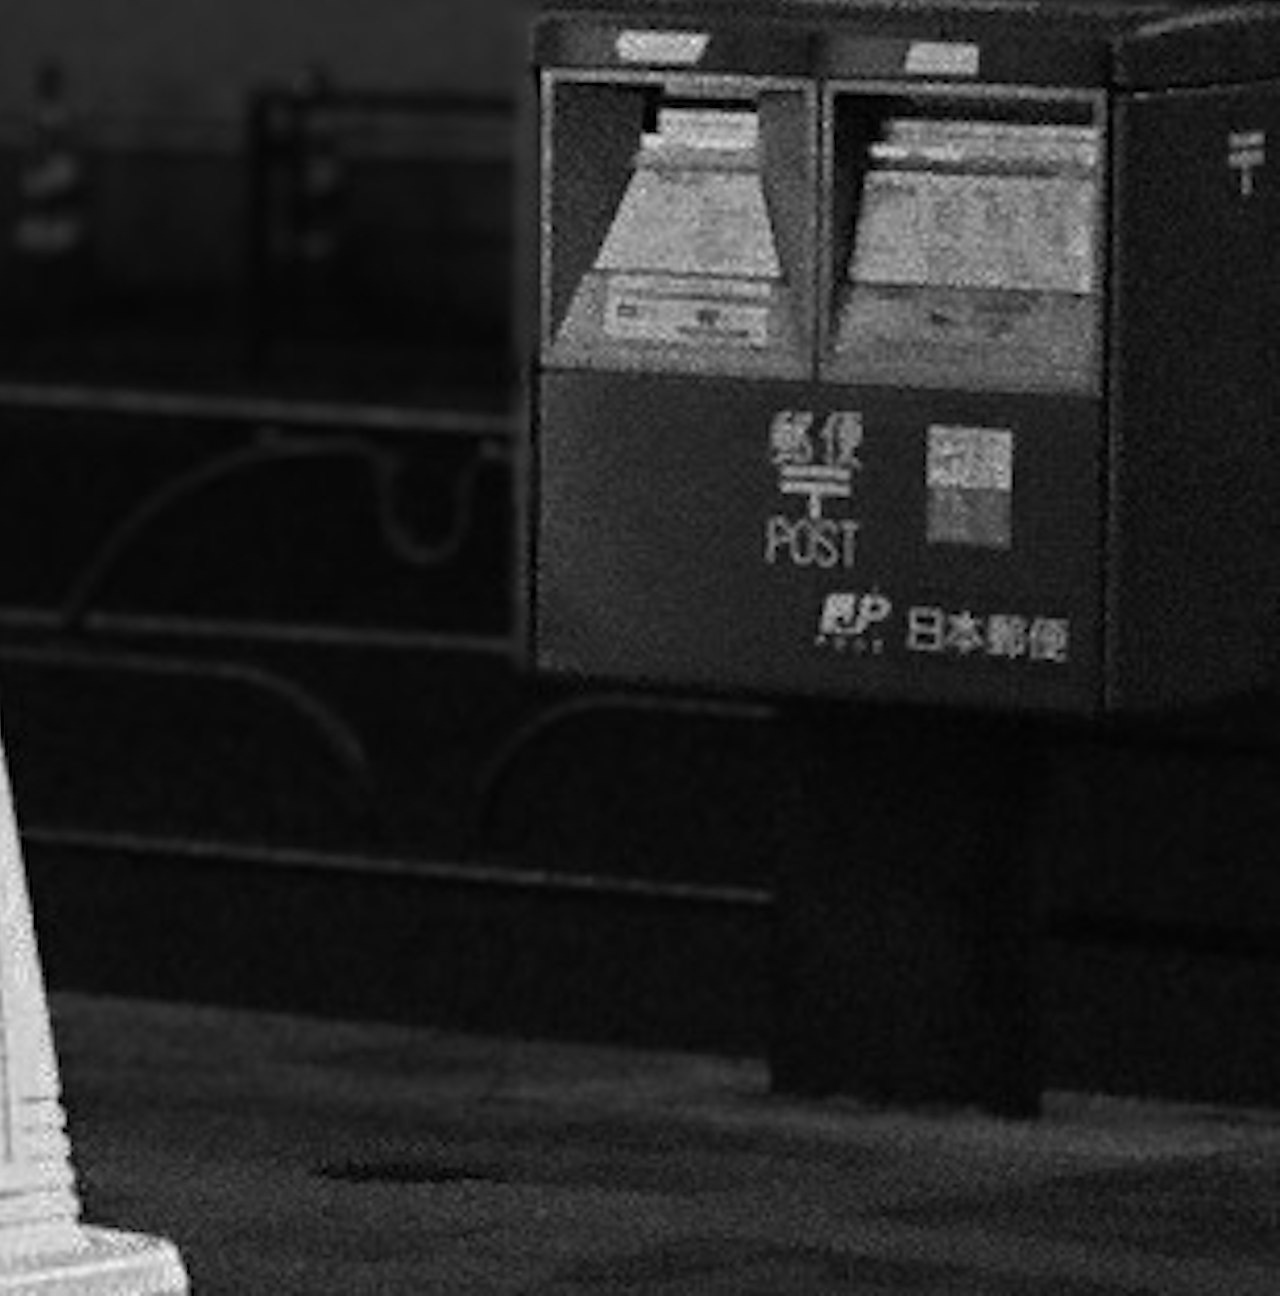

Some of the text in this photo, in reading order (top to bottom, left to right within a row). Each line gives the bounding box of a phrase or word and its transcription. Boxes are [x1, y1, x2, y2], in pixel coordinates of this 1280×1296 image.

[769, 409, 864, 469] 郵便
[764, 516, 860, 568] POST
[906, 606, 1070, 663] 日本郵便
